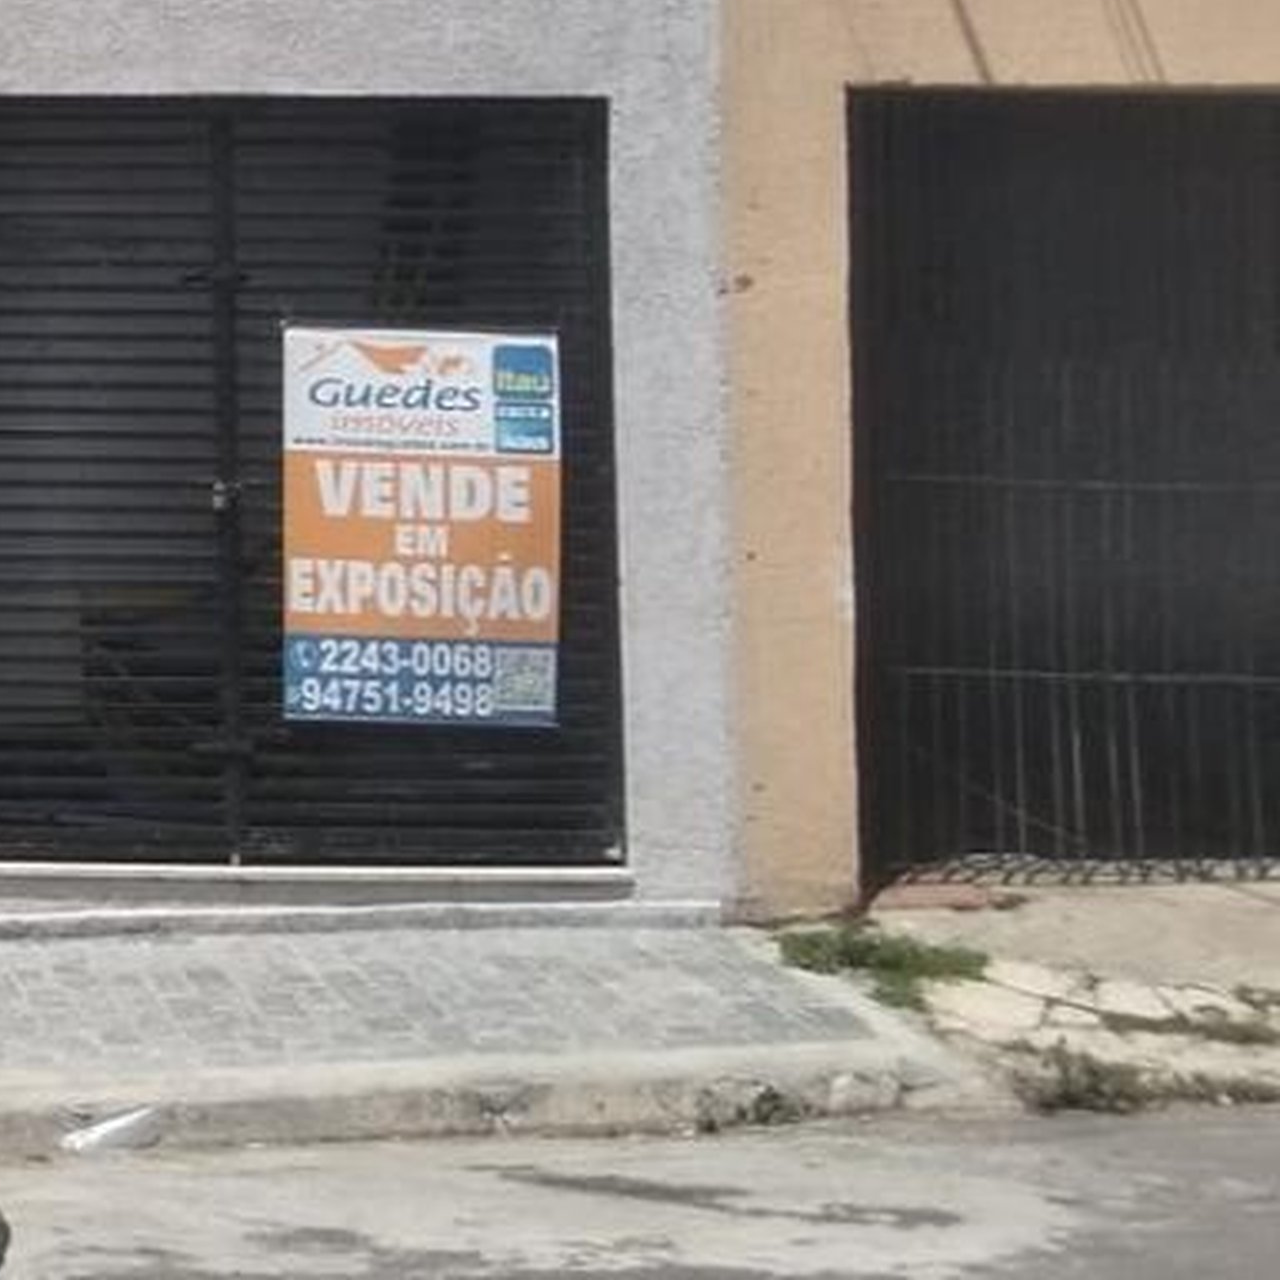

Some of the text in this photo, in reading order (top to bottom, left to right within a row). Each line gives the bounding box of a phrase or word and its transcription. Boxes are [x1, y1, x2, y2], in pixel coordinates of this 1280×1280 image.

[309, 377, 482, 410] Guedes
[315, 459, 533, 523] VENDE
[394, 524, 452, 557] EM
[288, 552, 553, 636] EXPOSIÇÃO
[319, 638, 494, 676] 2243-0068
[300, 678, 496, 717] 94751-9498
